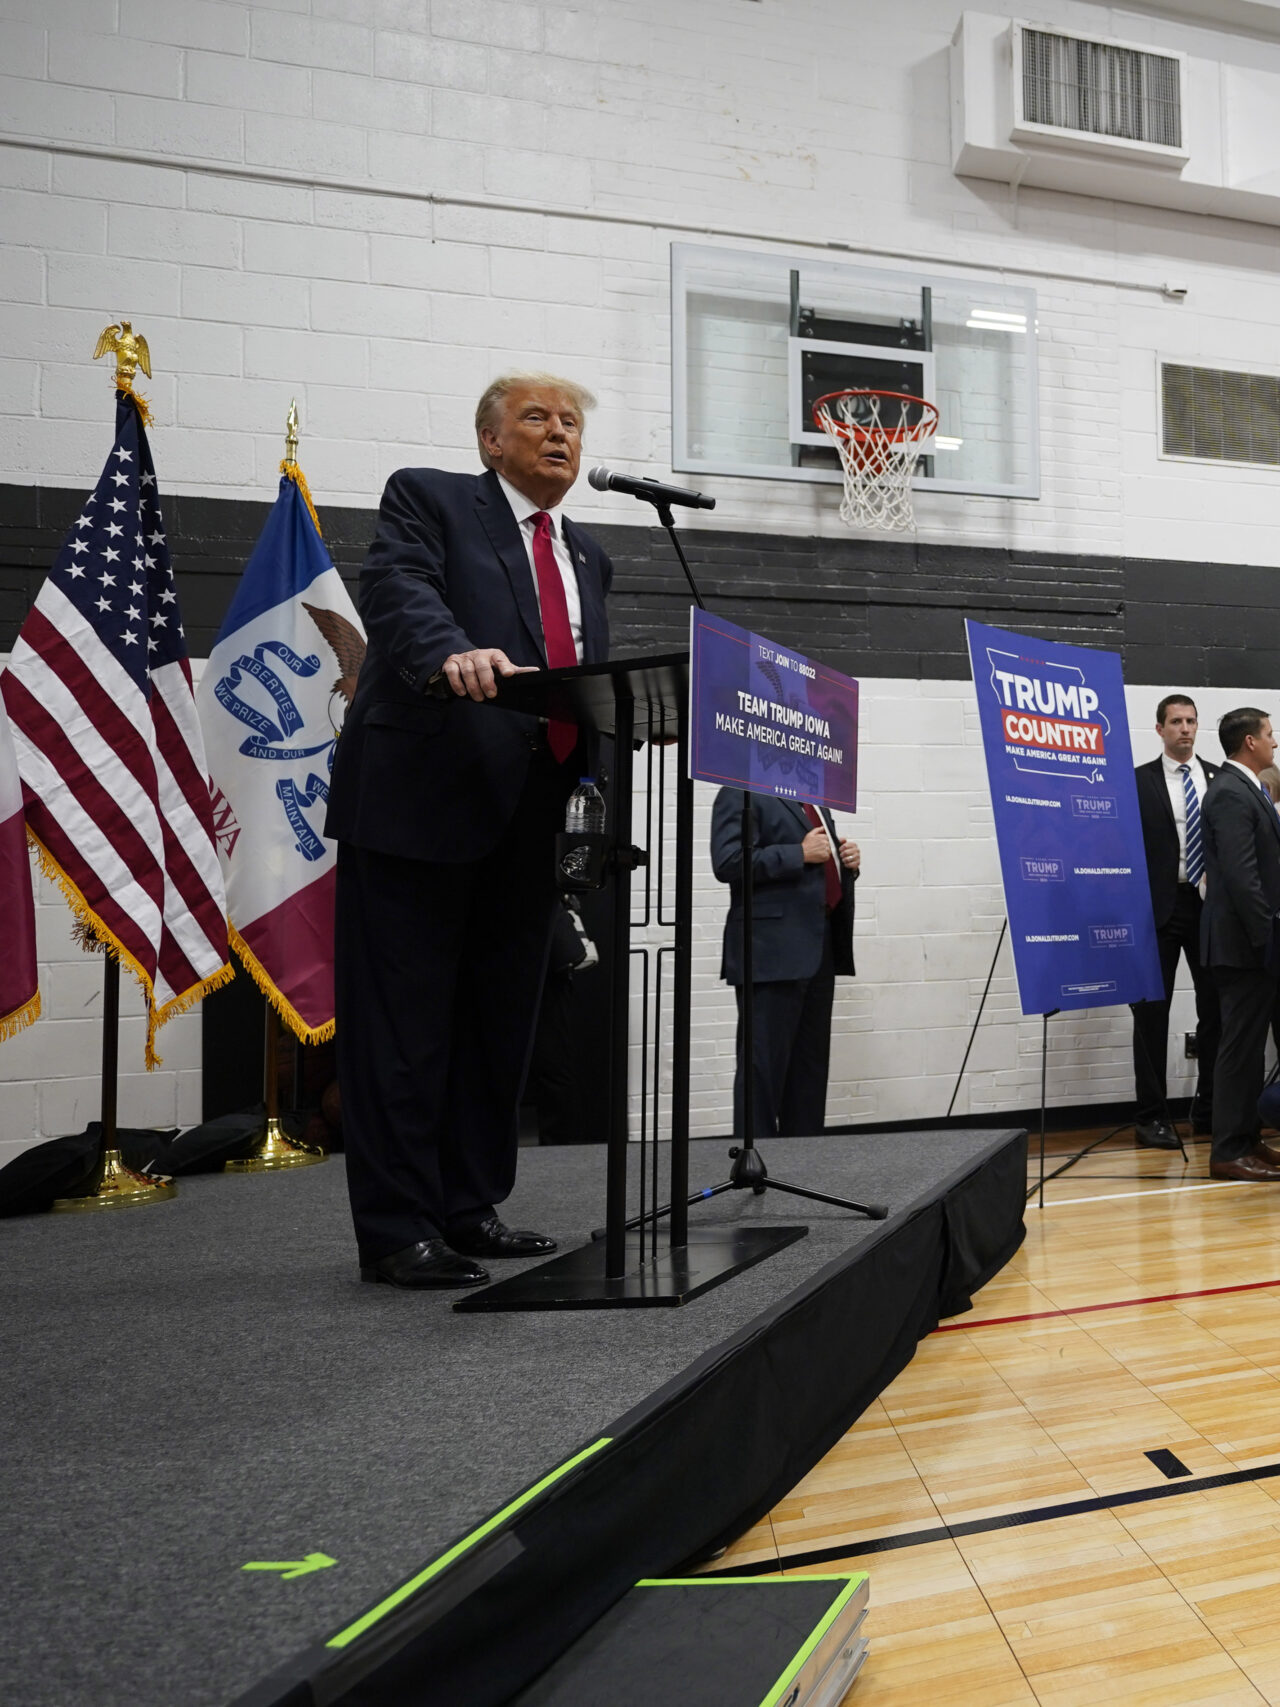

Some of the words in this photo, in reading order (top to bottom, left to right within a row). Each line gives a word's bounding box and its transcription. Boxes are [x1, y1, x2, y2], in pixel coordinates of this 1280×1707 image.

[277, 646, 303, 672] OUR
[758, 645, 774, 662] TEXT
[775, 653, 790, 669] JOIN
[790, 659, 798, 672] TO
[798, 663, 816, 680] 88022
[239, 656, 297, 721] LIBERTIES
[995, 669, 1099, 720] TRUMP
[215, 683, 233, 706] WE
[231, 702, 271, 731] PRIZE
[737, 690, 768, 719] TEAM
[770, 702, 803, 729] TRUMP
[805, 714, 830, 739] IOWA
[716, 712, 744, 737] MAKE
[746, 722, 787, 749] AMERICA
[788, 735, 816, 757] GREAT
[817, 743, 843, 764] AGAIN!
[1005, 714, 1099, 750] COUNTRY
[248, 746, 277, 758] AND
[282, 750, 305, 758] OUR
[1005, 745, 1025, 756] MAKE
[1026, 748, 1057, 761] AMERICA
[1058, 753, 1080, 763] GREAT
[1082, 756, 1107, 766] AGAIN!
[312, 780, 330, 800] WE
[1096, 773, 1104, 782] IA
[209, 774, 241, 861] WA
[282, 786, 318, 850] MAINTAIN
[1076, 799, 1111, 811] TRUMP
[1025, 861, 1058, 874] TRUMP
[1093, 928, 1128, 940] TRUMP
